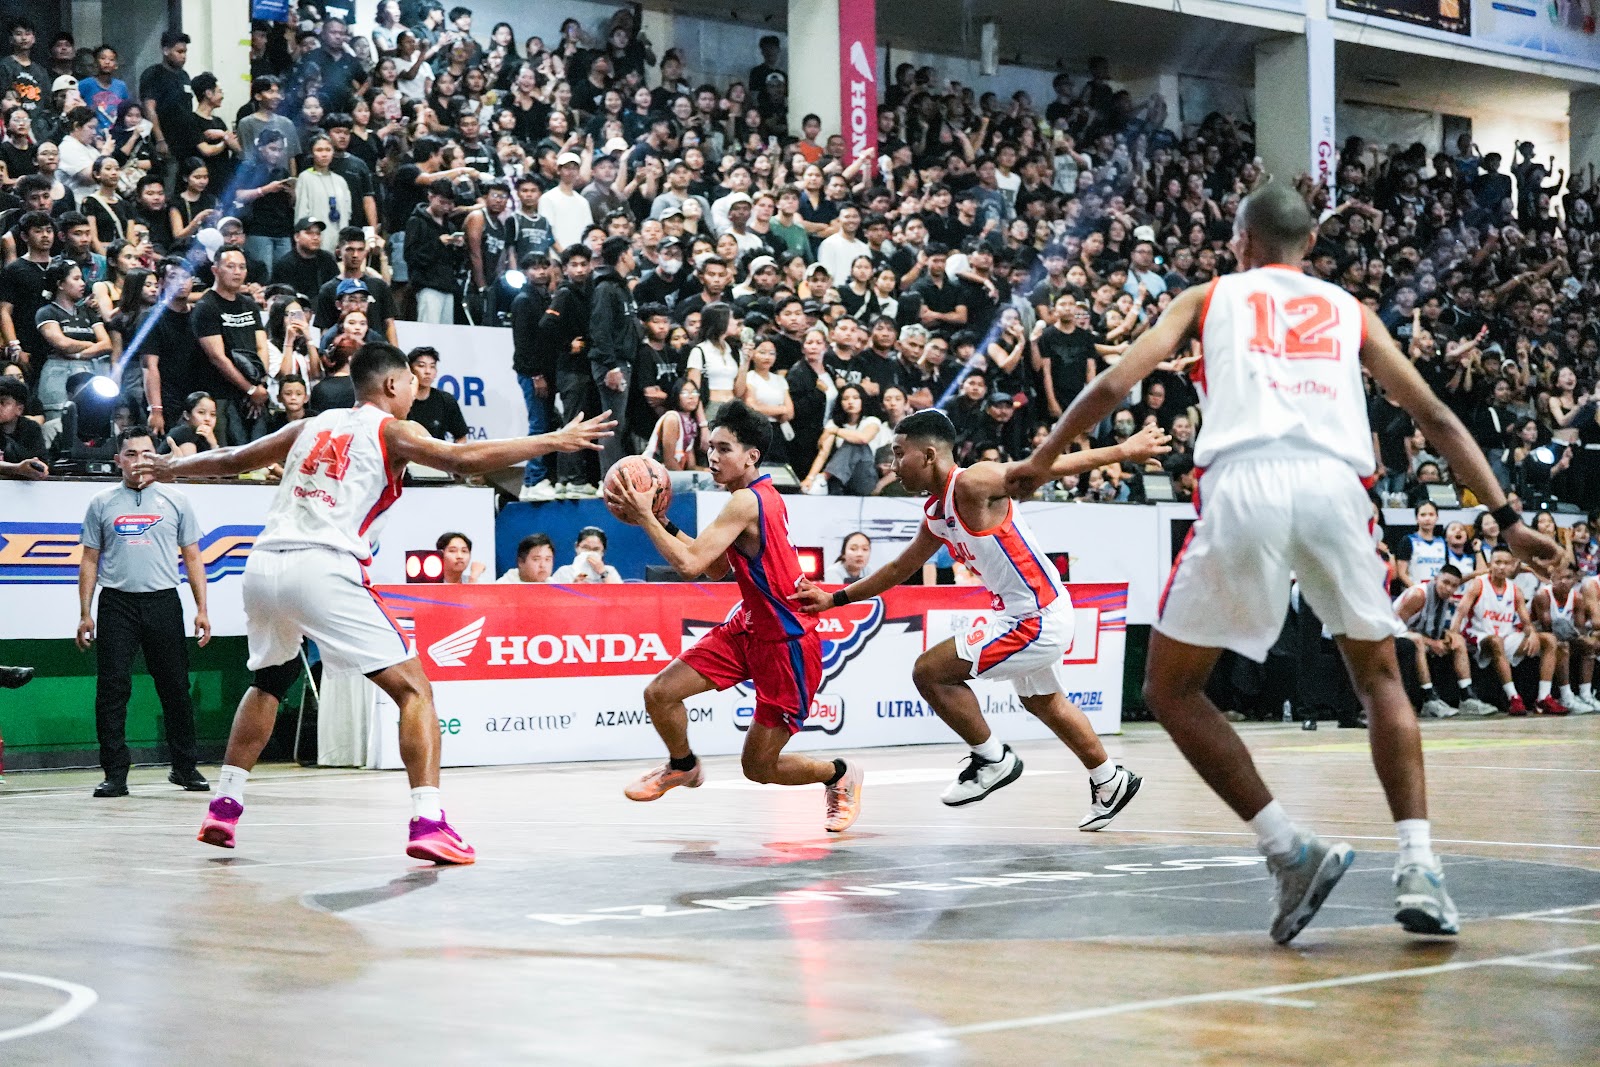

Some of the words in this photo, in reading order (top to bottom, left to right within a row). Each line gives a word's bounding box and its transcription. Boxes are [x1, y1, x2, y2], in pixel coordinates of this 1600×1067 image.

[851, 80, 868, 164] HON
[1318, 141, 1331, 185] Go
[1247, 292, 1341, 361] 12
[437, 374, 486, 407] OR
[486, 632, 672, 665] HONDA
[595, 707, 713, 727] AZAWEOM
[809, 699, 837, 723] Day
[877, 700, 924, 718] ULTRA
[983, 693, 1025, 714] Jacks
[485, 714, 571, 732] azarine
